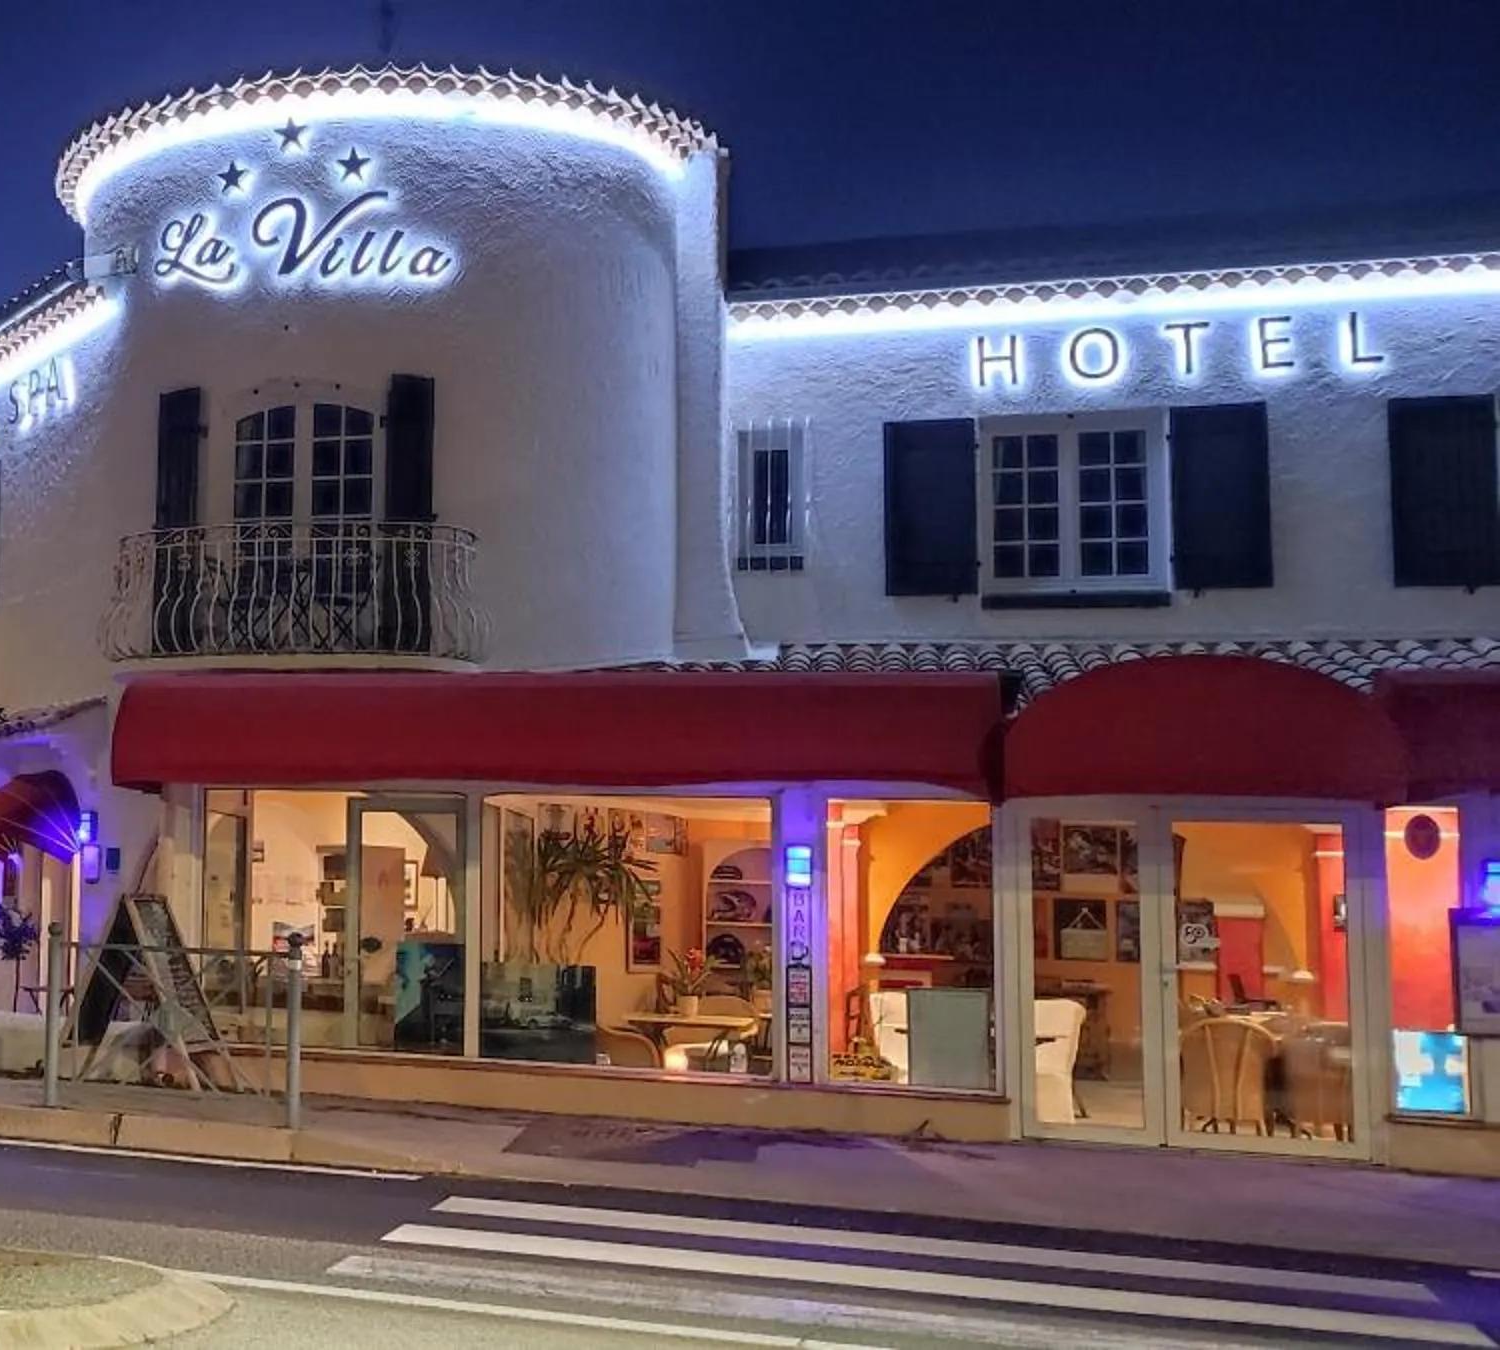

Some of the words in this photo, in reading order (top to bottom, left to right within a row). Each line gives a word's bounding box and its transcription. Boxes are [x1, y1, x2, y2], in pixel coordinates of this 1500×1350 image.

[153, 213, 235, 284] La
[251, 190, 451, 279] Villa
[977, 311, 1384, 387] HOTEL
[8, 356, 69, 425] SPA
[793, 892, 805, 939] BAR
